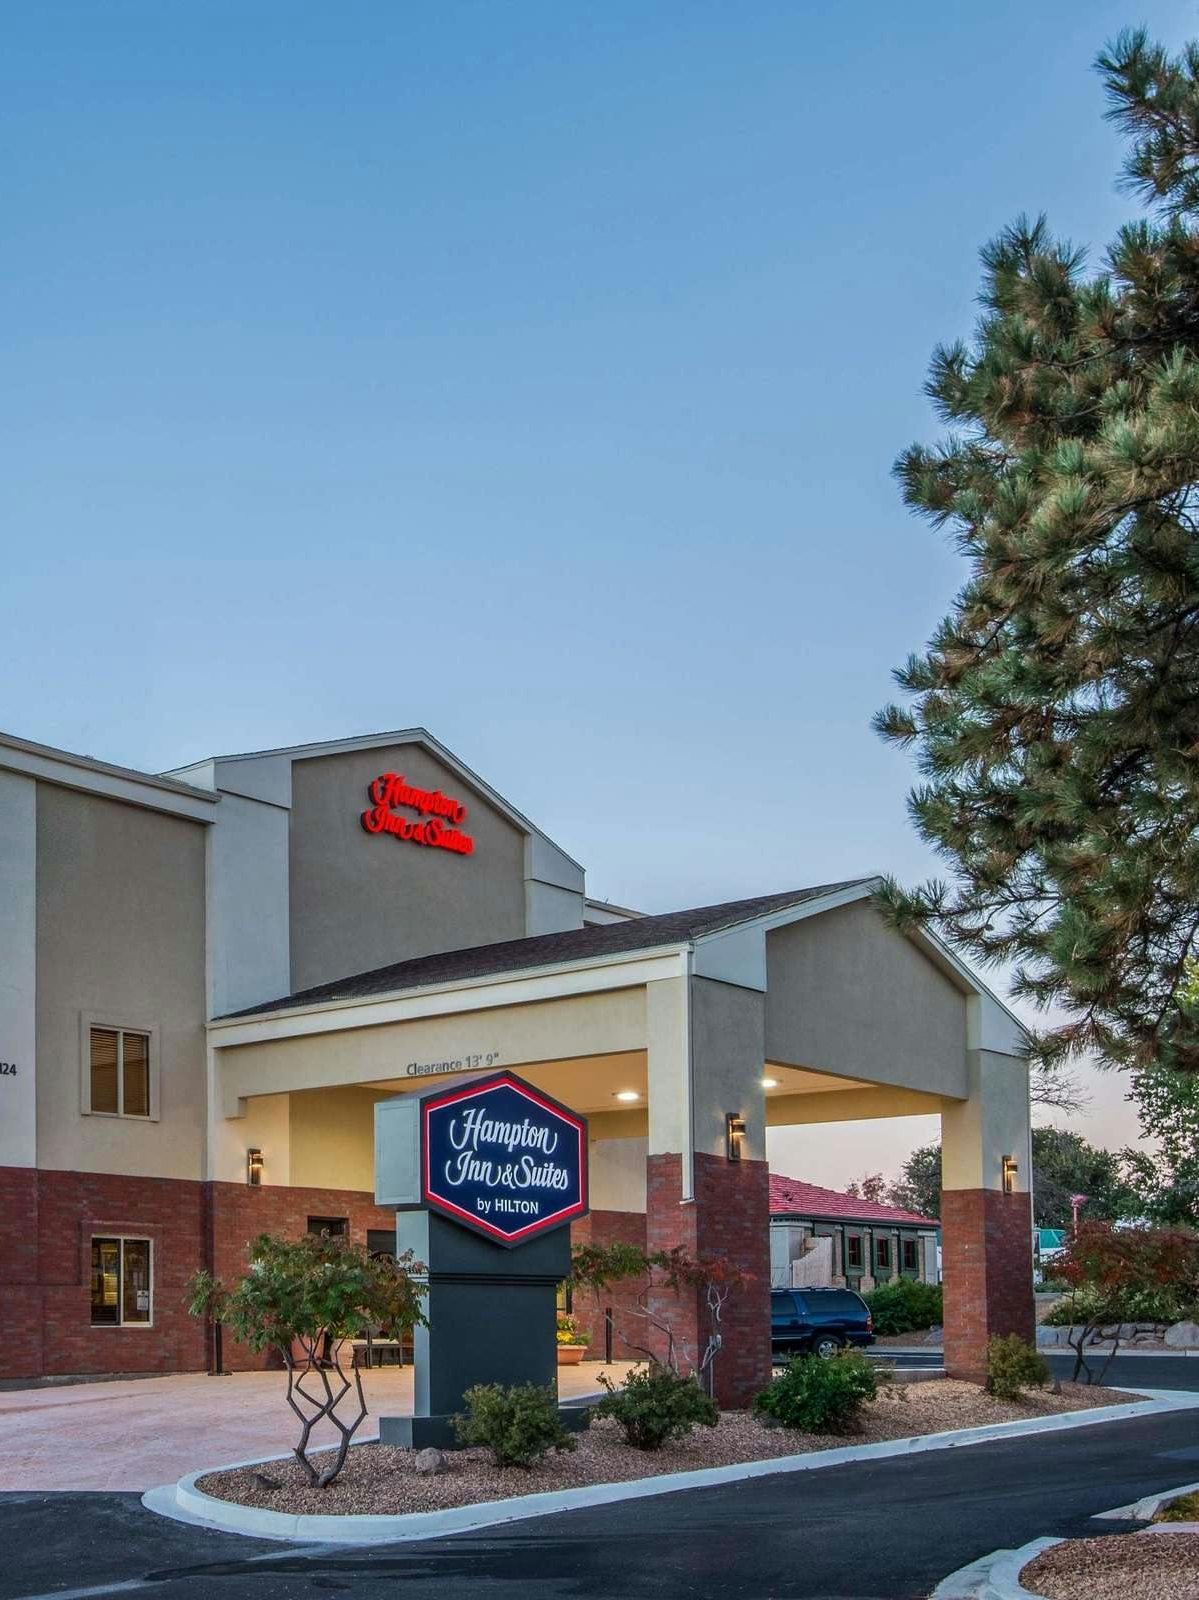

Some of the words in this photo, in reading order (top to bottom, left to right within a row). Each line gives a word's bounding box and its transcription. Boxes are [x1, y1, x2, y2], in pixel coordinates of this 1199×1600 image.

[371, 773, 466, 823] Hampton
[406, 1061, 462, 1076] Clearance
[449, 1108, 558, 1154] Hampton
[446, 1150, 502, 1187] Inn
[514, 1155, 569, 1190] Suites
[477, 1198, 491, 1214] by
[495, 1199, 539, 1215] HILTON
